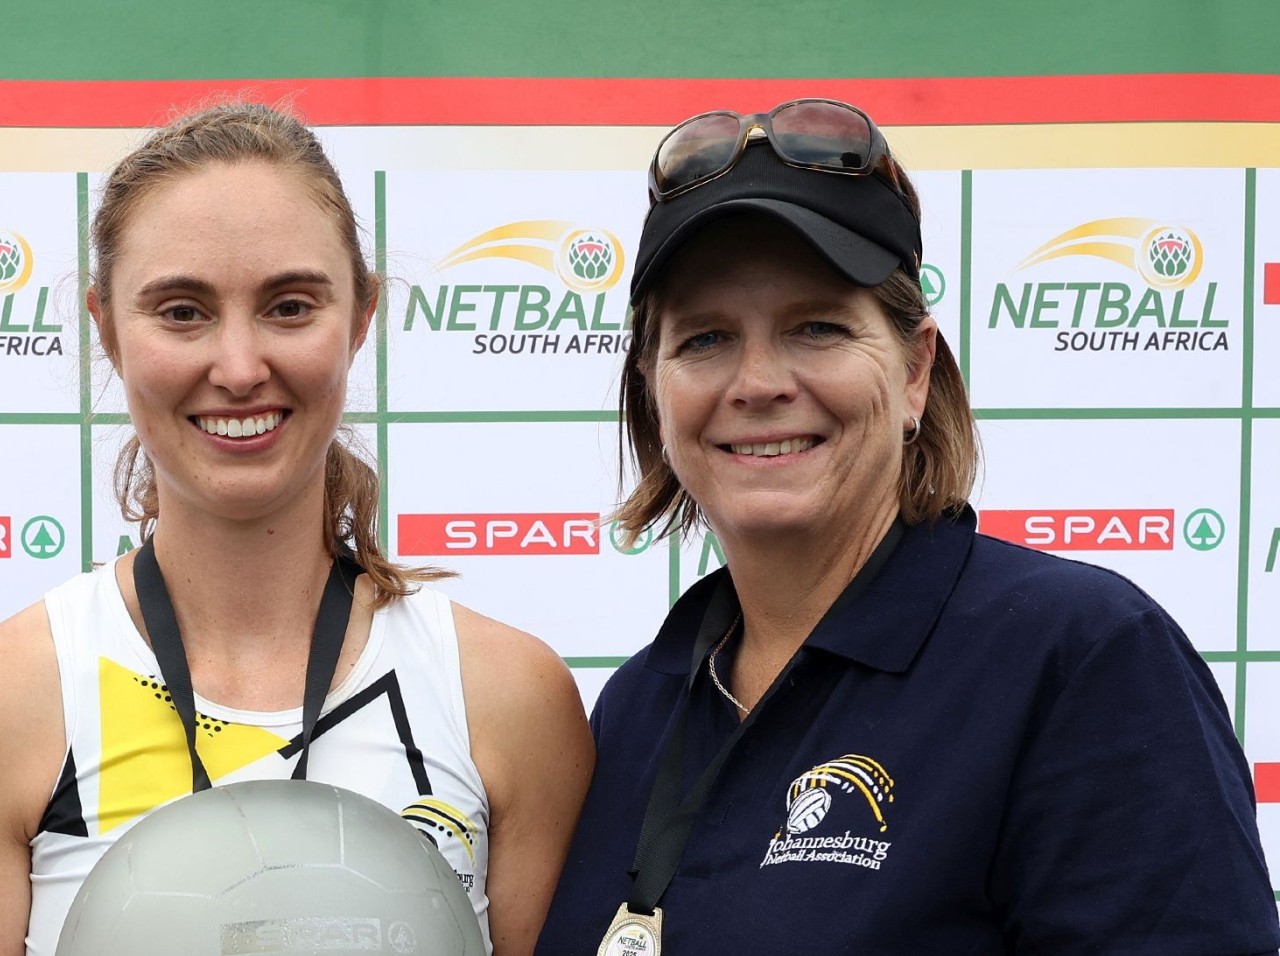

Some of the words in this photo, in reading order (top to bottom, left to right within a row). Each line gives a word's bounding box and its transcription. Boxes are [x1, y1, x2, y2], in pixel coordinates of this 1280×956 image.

[988, 282, 1229, 329] NETBALL
[472, 334, 560, 354] SOUTH
[564, 334, 632, 354] AFRI
[1054, 331, 1139, 351] SOUTH
[1143, 331, 1229, 351] AFRICA
[445, 520, 596, 549] SPAR
[1024, 516, 1170, 544] SPAR
[760, 830, 891, 869] Johannesburg
[765, 849, 805, 865] Netball
[803, 849, 881, 870] Association
